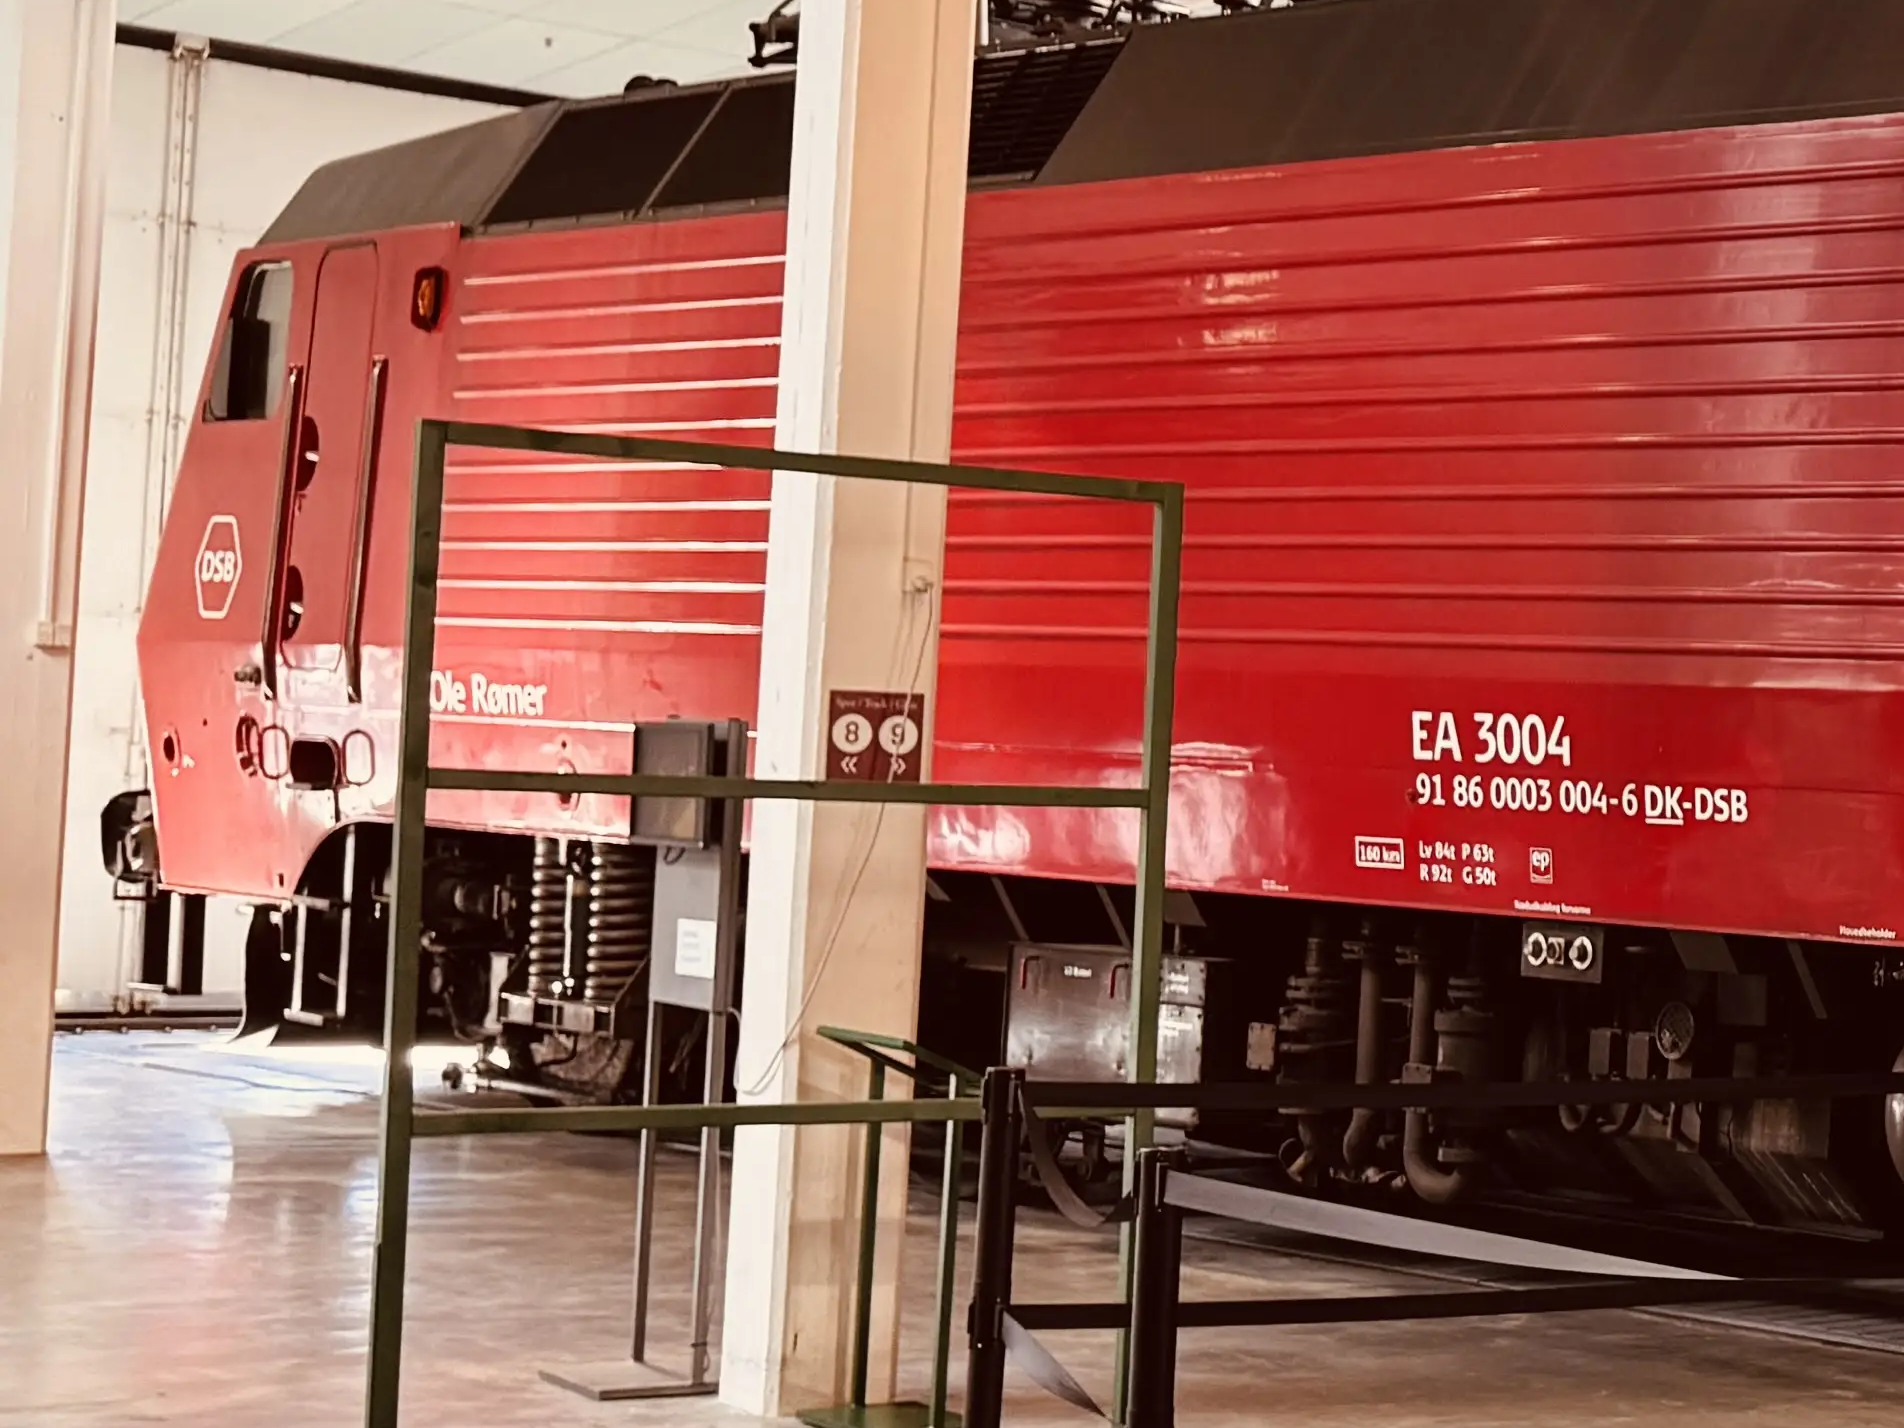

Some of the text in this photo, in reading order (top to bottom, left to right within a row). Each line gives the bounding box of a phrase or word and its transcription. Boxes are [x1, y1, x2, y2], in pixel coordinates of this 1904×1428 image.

[201, 550, 236, 582] DSB
[430, 670, 466, 713] Ole
[845, 721, 906, 746] 8 9
[1412, 710, 1571, 767] EA 3004
[1416, 772, 1748, 824] 91 86 0003 004-6 DK-DSB
[1360, 844, 1400, 863] 160 km
[1419, 840, 1494, 863] Lv 84t P 63t
[1532, 851, 1550, 872] ep
[1420, 863, 1497, 886] R 92t G 50t
